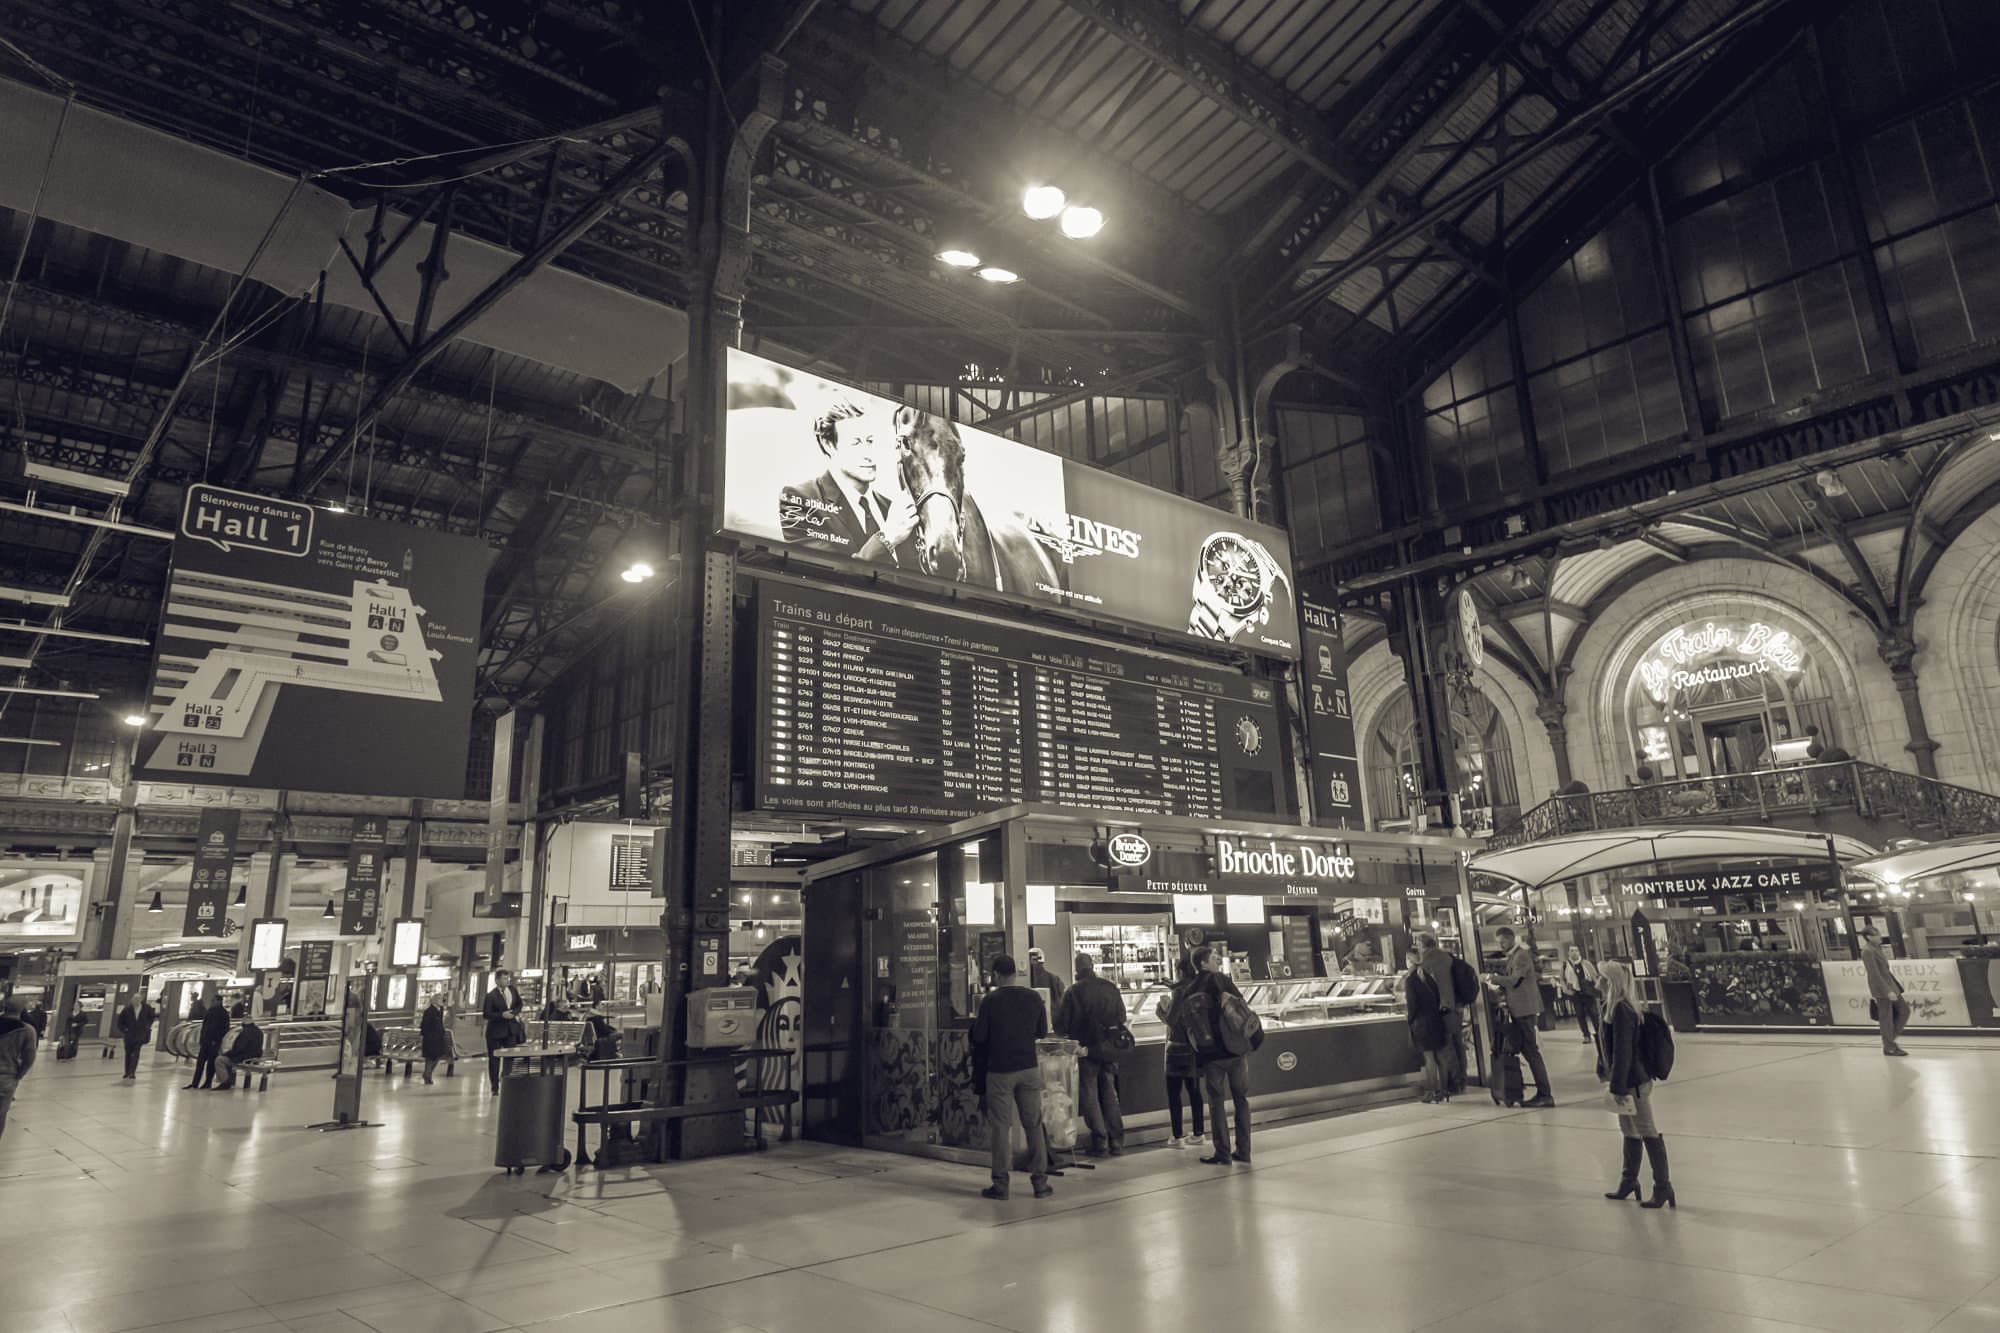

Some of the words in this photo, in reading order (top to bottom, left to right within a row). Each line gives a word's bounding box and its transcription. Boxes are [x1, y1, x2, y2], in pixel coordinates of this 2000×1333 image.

[201, 493, 259, 513] Bienvenue
[263, 506, 288, 518] dans
[291, 511, 302, 521] le
[790, 495, 802, 505] an
[196, 506, 268, 541] Hall
[286, 524, 300, 547] 1
[806, 528, 829, 541] Simon
[830, 534, 850, 545] Baker
[320, 539, 335, 548] Rue
[348, 545, 369, 556] Bercy
[319, 550, 335, 558] vers
[336, 551, 354, 561] Gare
[367, 557, 389, 568] Bercy
[317, 558, 333, 566] vers
[335, 560, 353, 570] Gare
[354, 564, 399, 578] d'Austerlitz
[369, 602, 396, 617] Hall
[400, 608, 407, 619] 1
[773, 600, 812, 618] Trains
[817, 610, 831, 622] au
[835, 613, 873, 630] départ
[1304, 608, 1329, 628] Hall
[1331, 616, 1338, 630] 1
[371, 619, 380, 629] A
[392, 622, 401, 632] N
[428, 622, 447, 631] Place
[427, 631, 446, 640] Louis
[446, 633, 474, 644] Armand
[881, 624, 900, 635] Train
[902, 628, 940, 642] departures
[944, 635, 961, 645] Treni
[962, 638, 969, 647] in
[971, 641, 999, 653] partenza
[1660, 622, 1735, 664] Train
[1737, 622, 1800, 672] Bleu
[1671, 656, 1769, 690] Restaurant
[185, 703, 212, 715] Hall
[215, 705, 224, 716] 2
[1314, 693, 1324, 711] A
[1337, 696, 1347, 715] N
[207, 719, 220, 729] 23
[178, 741, 205, 754] Hall
[208, 743, 217, 754] 3
[181, 757, 189, 766] A
[203, 758, 211, 767] N
[765, 795, 779, 805] Les
[782, 796, 804, 807] voies
[806, 798, 824, 809] sont
[826, 799, 861, 811] affichées
[863, 803, 873, 812] au
[875, 803, 891, 814] plus
[892, 803, 908, 814] tard
[909, 805, 919, 814] 20
[920, 806, 949, 817] minutes
[950, 809, 970, 817] avant
[1115, 838, 1146, 854] Brioche
[1218, 840, 1295, 875] Brioche
[1300, 845, 1356, 878] Dorée
[1147, 880, 1169, 891] PETIT
[1622, 878, 1707, 896] MONTREUX
[1712, 875, 1753, 890] JAZZ
[1758, 872, 1801, 887] CAFE
[571, 933, 596, 950] RELAY
[1841, 963, 1939, 977] MOREUX
[1903, 980, 1942, 992] AZZ
[1848, 997, 1871, 1009] CA
